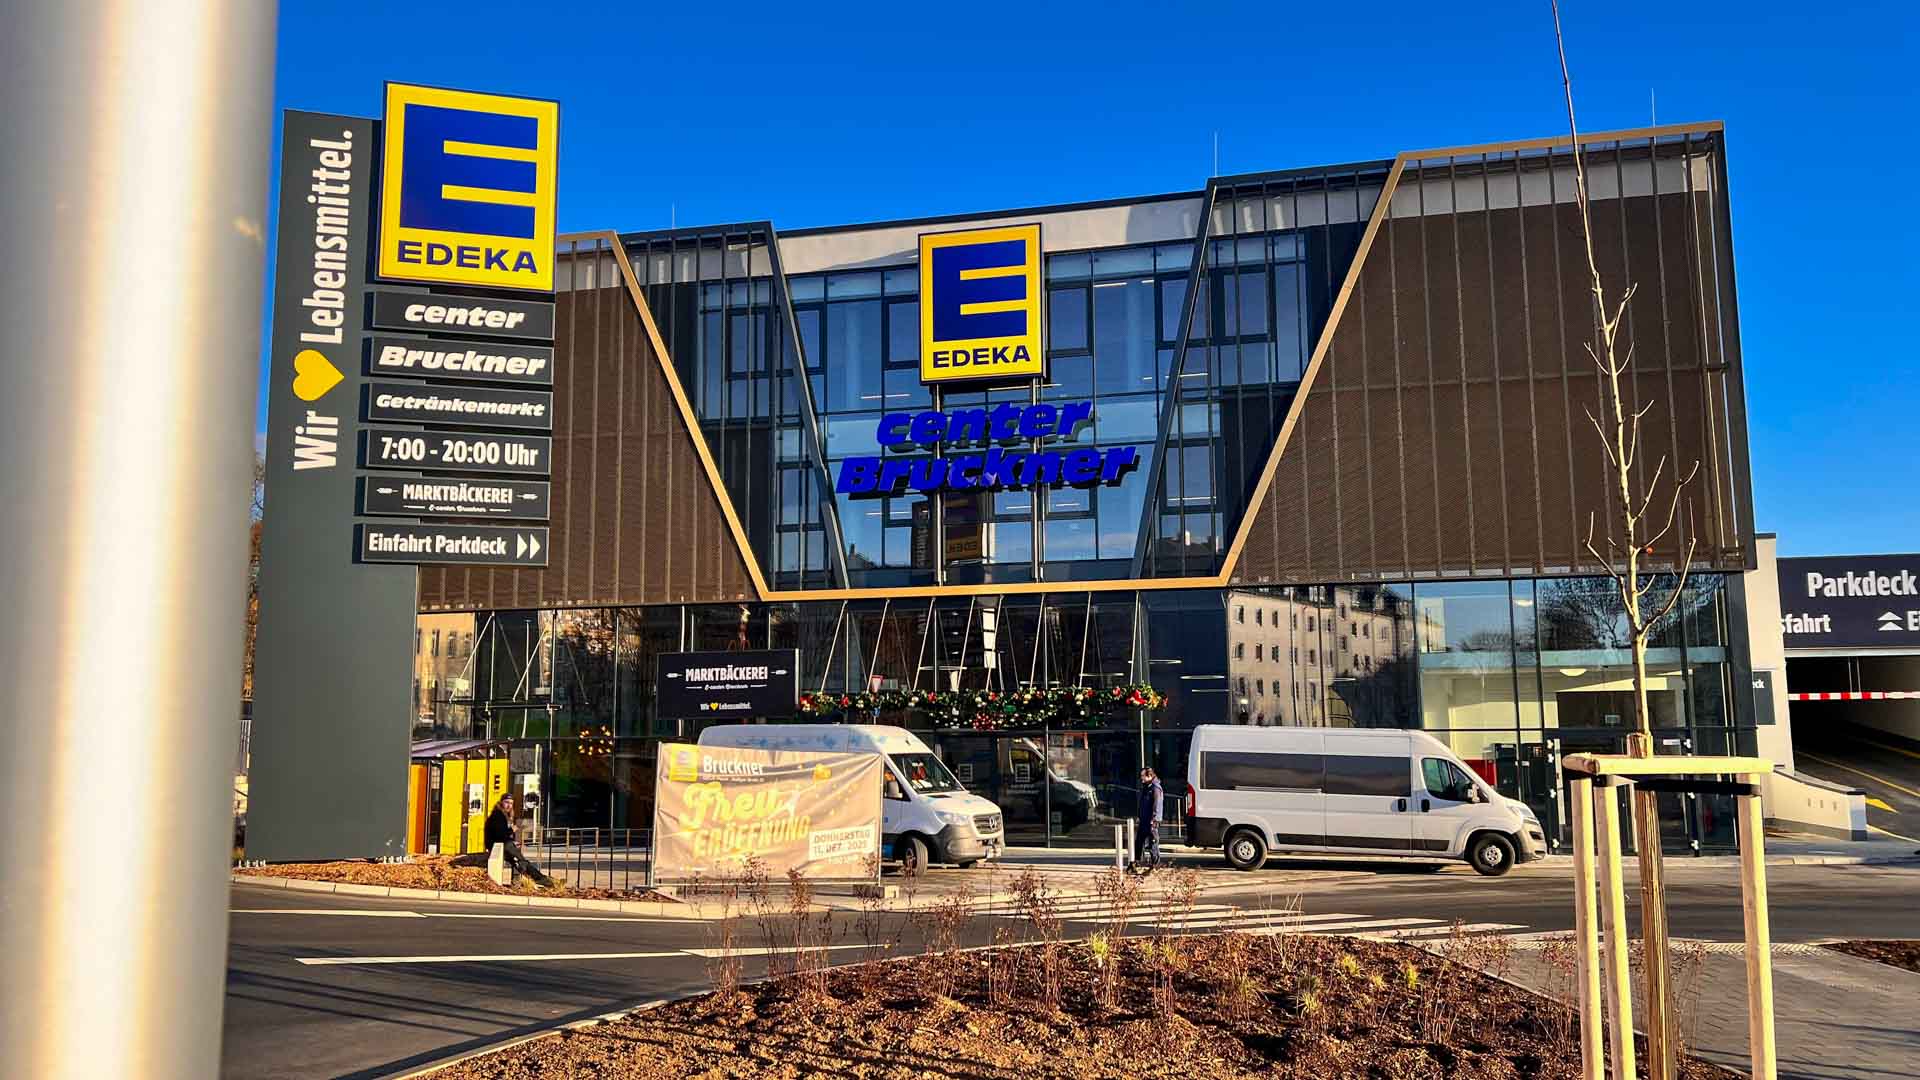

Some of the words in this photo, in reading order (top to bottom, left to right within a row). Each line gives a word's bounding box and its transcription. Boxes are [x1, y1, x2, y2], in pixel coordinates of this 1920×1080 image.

[300, 130, 353, 344] Lebensmittel.
[397, 240, 538, 274] EDEKA
[404, 303, 524, 329] center
[378, 345, 546, 376] Bruckner
[932, 345, 1031, 369] EDEKA
[376, 393, 545, 417] Getränkemarkt
[876, 401, 1093, 447] center
[294, 410, 339, 471] Wir
[380, 437, 425, 460] 7:00
[441, 440, 500, 465] 20:00
[504, 443, 539, 466] Uhr
[835, 446, 1137, 494] Bruckner
[402, 483, 513, 504] MARKTBÄCKEREI
[368, 532, 432, 552] Einfahrt
[435, 535, 507, 555] Parkdeck
[1807, 570, 1918, 597] Parkdeck
[1907, 611, 1920, 631] E
[685, 664, 768, 682] MARKTBÄCKEREI
[703, 755, 763, 775] Bruckner
[692, 815, 811, 858] ERÖFFNUNG
